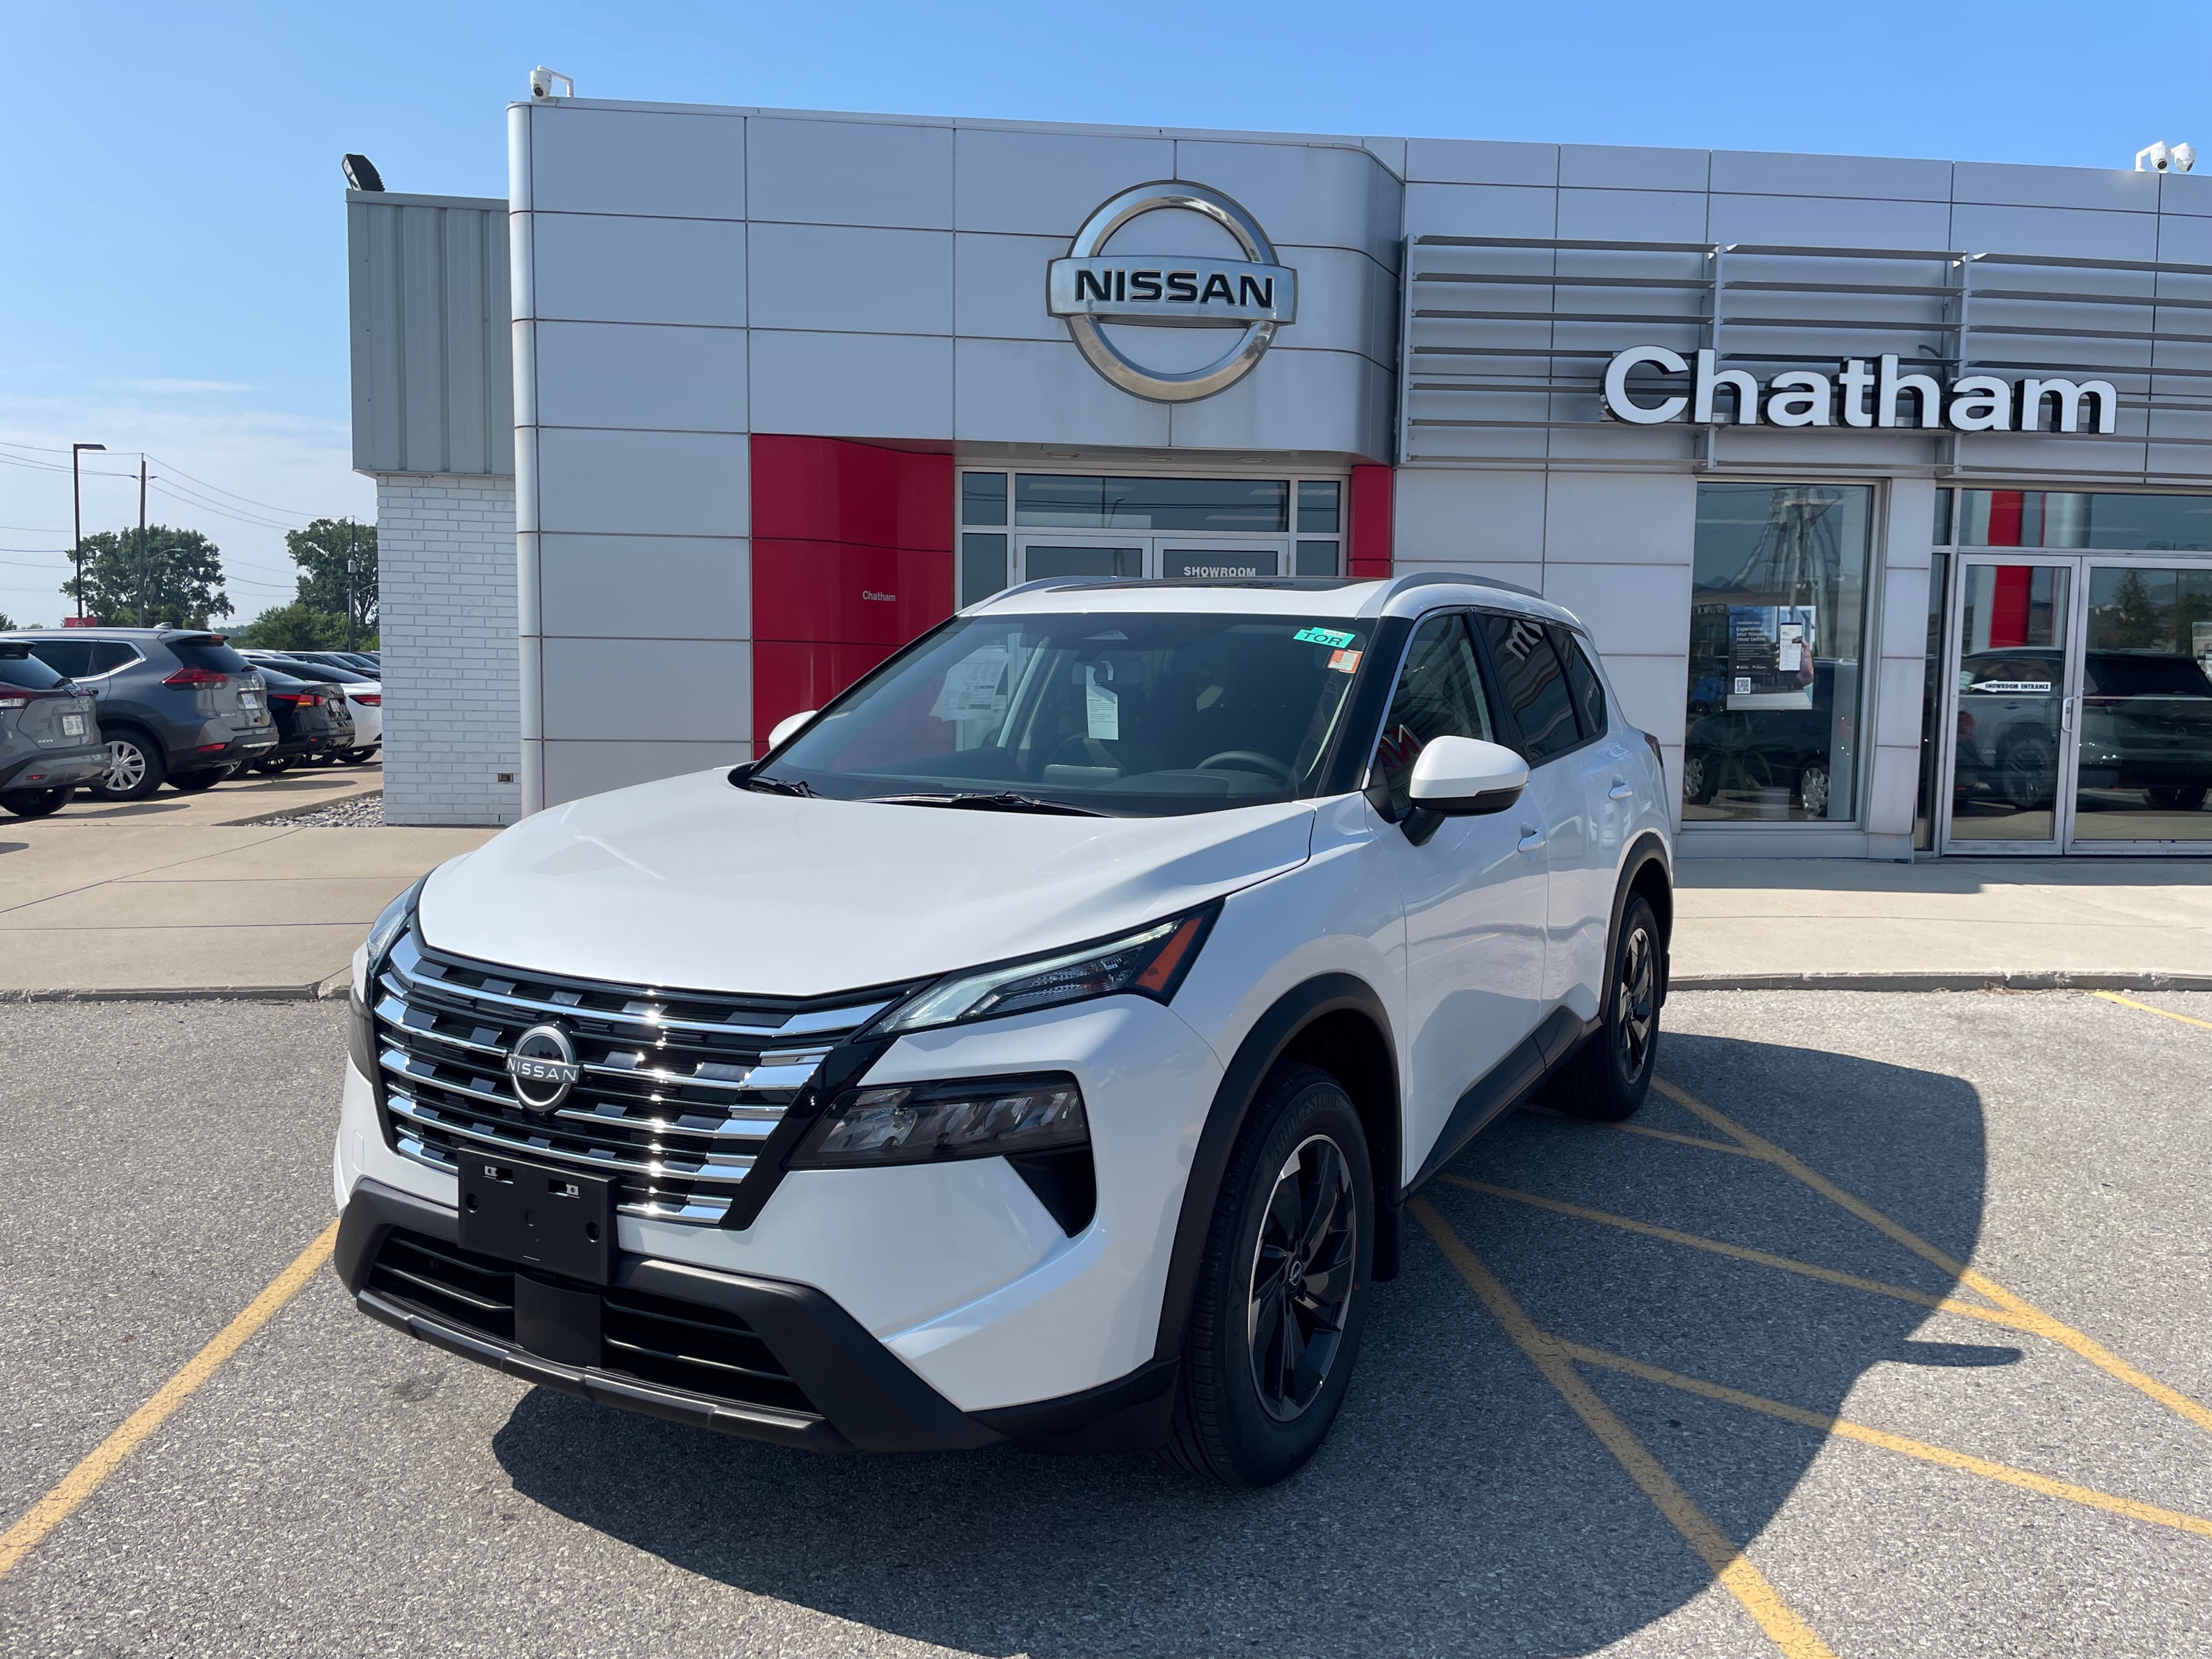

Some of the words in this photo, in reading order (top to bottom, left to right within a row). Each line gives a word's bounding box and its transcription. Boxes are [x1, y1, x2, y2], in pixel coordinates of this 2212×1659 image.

[1076, 269, 1275, 309] NISSAN
[1602, 345, 2118, 435] Chatham
[1183, 566, 1256, 577] SHOWROOM
[863, 590, 896, 602] Chatham
[1303, 631, 1343, 646] TOR
[507, 1058, 577, 1082] NISSAN
